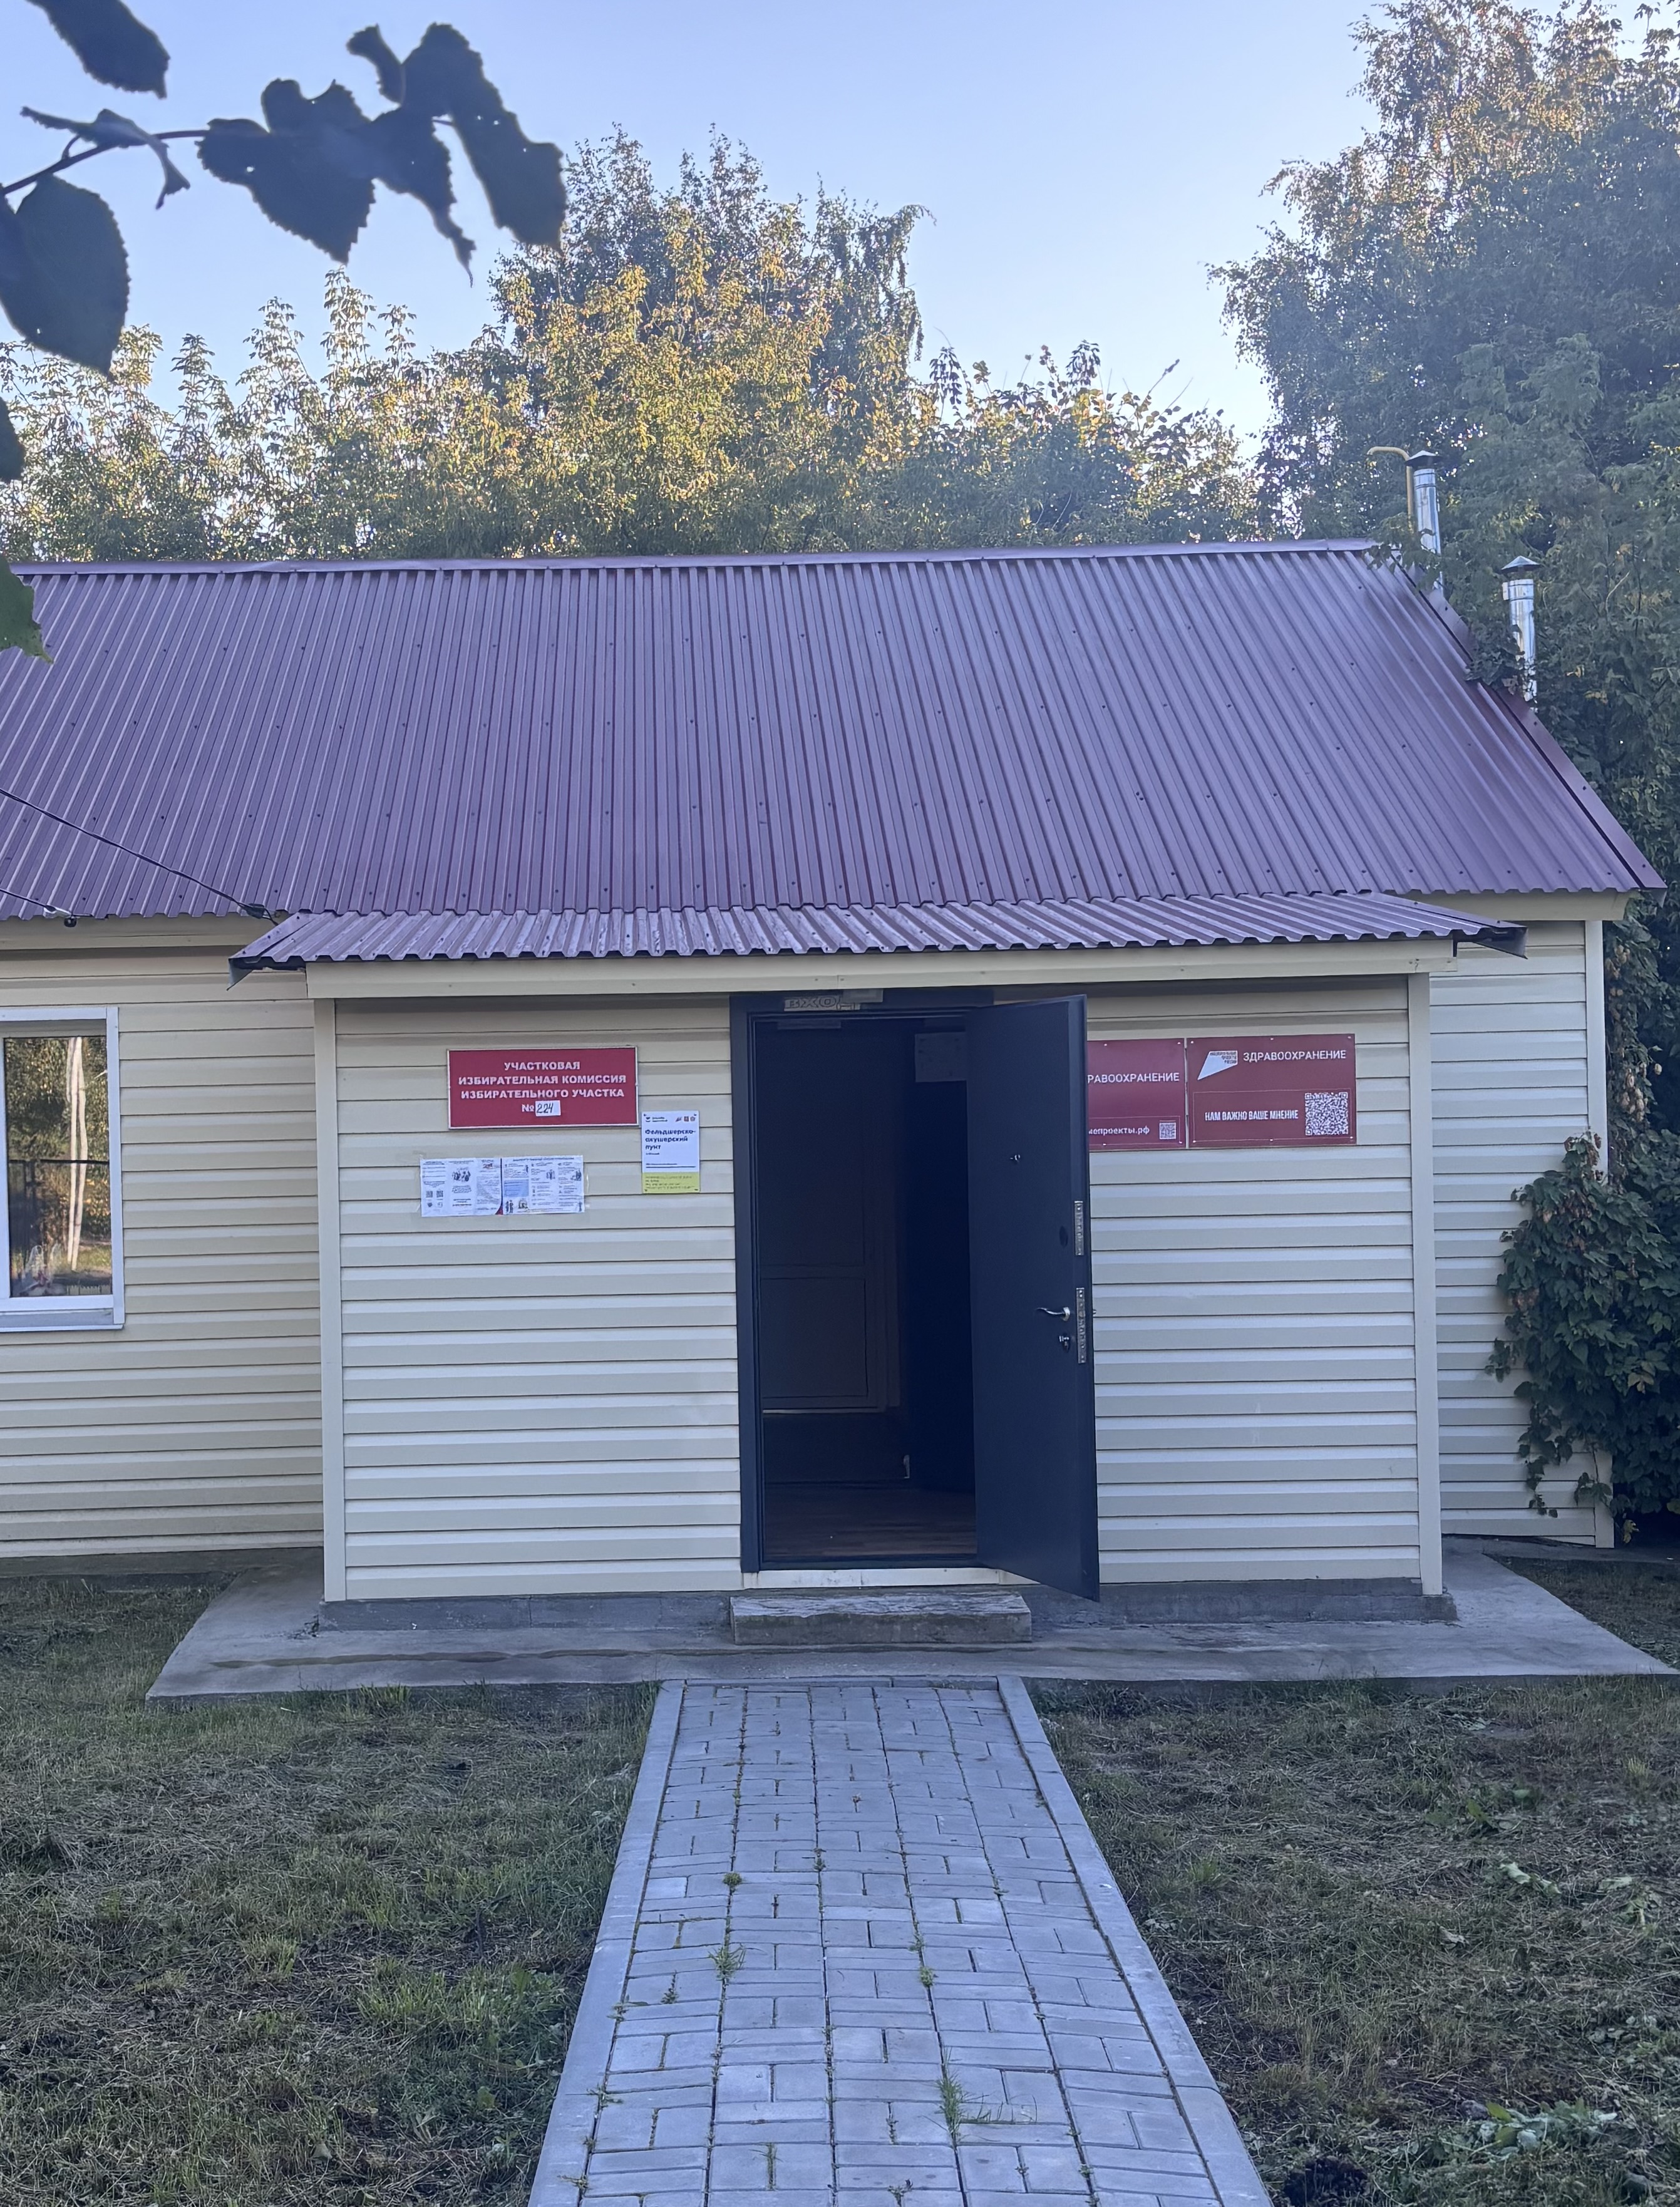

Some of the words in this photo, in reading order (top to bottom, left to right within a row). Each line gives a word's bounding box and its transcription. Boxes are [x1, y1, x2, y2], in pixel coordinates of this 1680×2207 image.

[1243, 1050, 1347, 1063] ЗДРАВООХРАНЕНИЕ
[504, 1062, 580, 1070] УЧАСТКОВАЯ
[458, 1076, 559, 1085] ИЗБИРАТЕЛЬНАЯ
[562, 1075, 627, 1084] КОМИССИЯ
[1087, 1072, 1180, 1084] РАВООХРАНЕНИЕ
[461, 1089, 569, 1099] ИЗБИРАТЕЛЬНОГО
[572, 1088, 624, 1098] УЧАСТКА
[1205, 1112, 1221, 1121] НАМ
[1222, 1111, 1247, 1120] ВАЖНО
[1249, 1110, 1269, 1120] ВАШЕ
[1270, 1110, 1299, 1120] МНЕНИЕ
[1088, 1125, 1150, 1136] епроекты.рф
